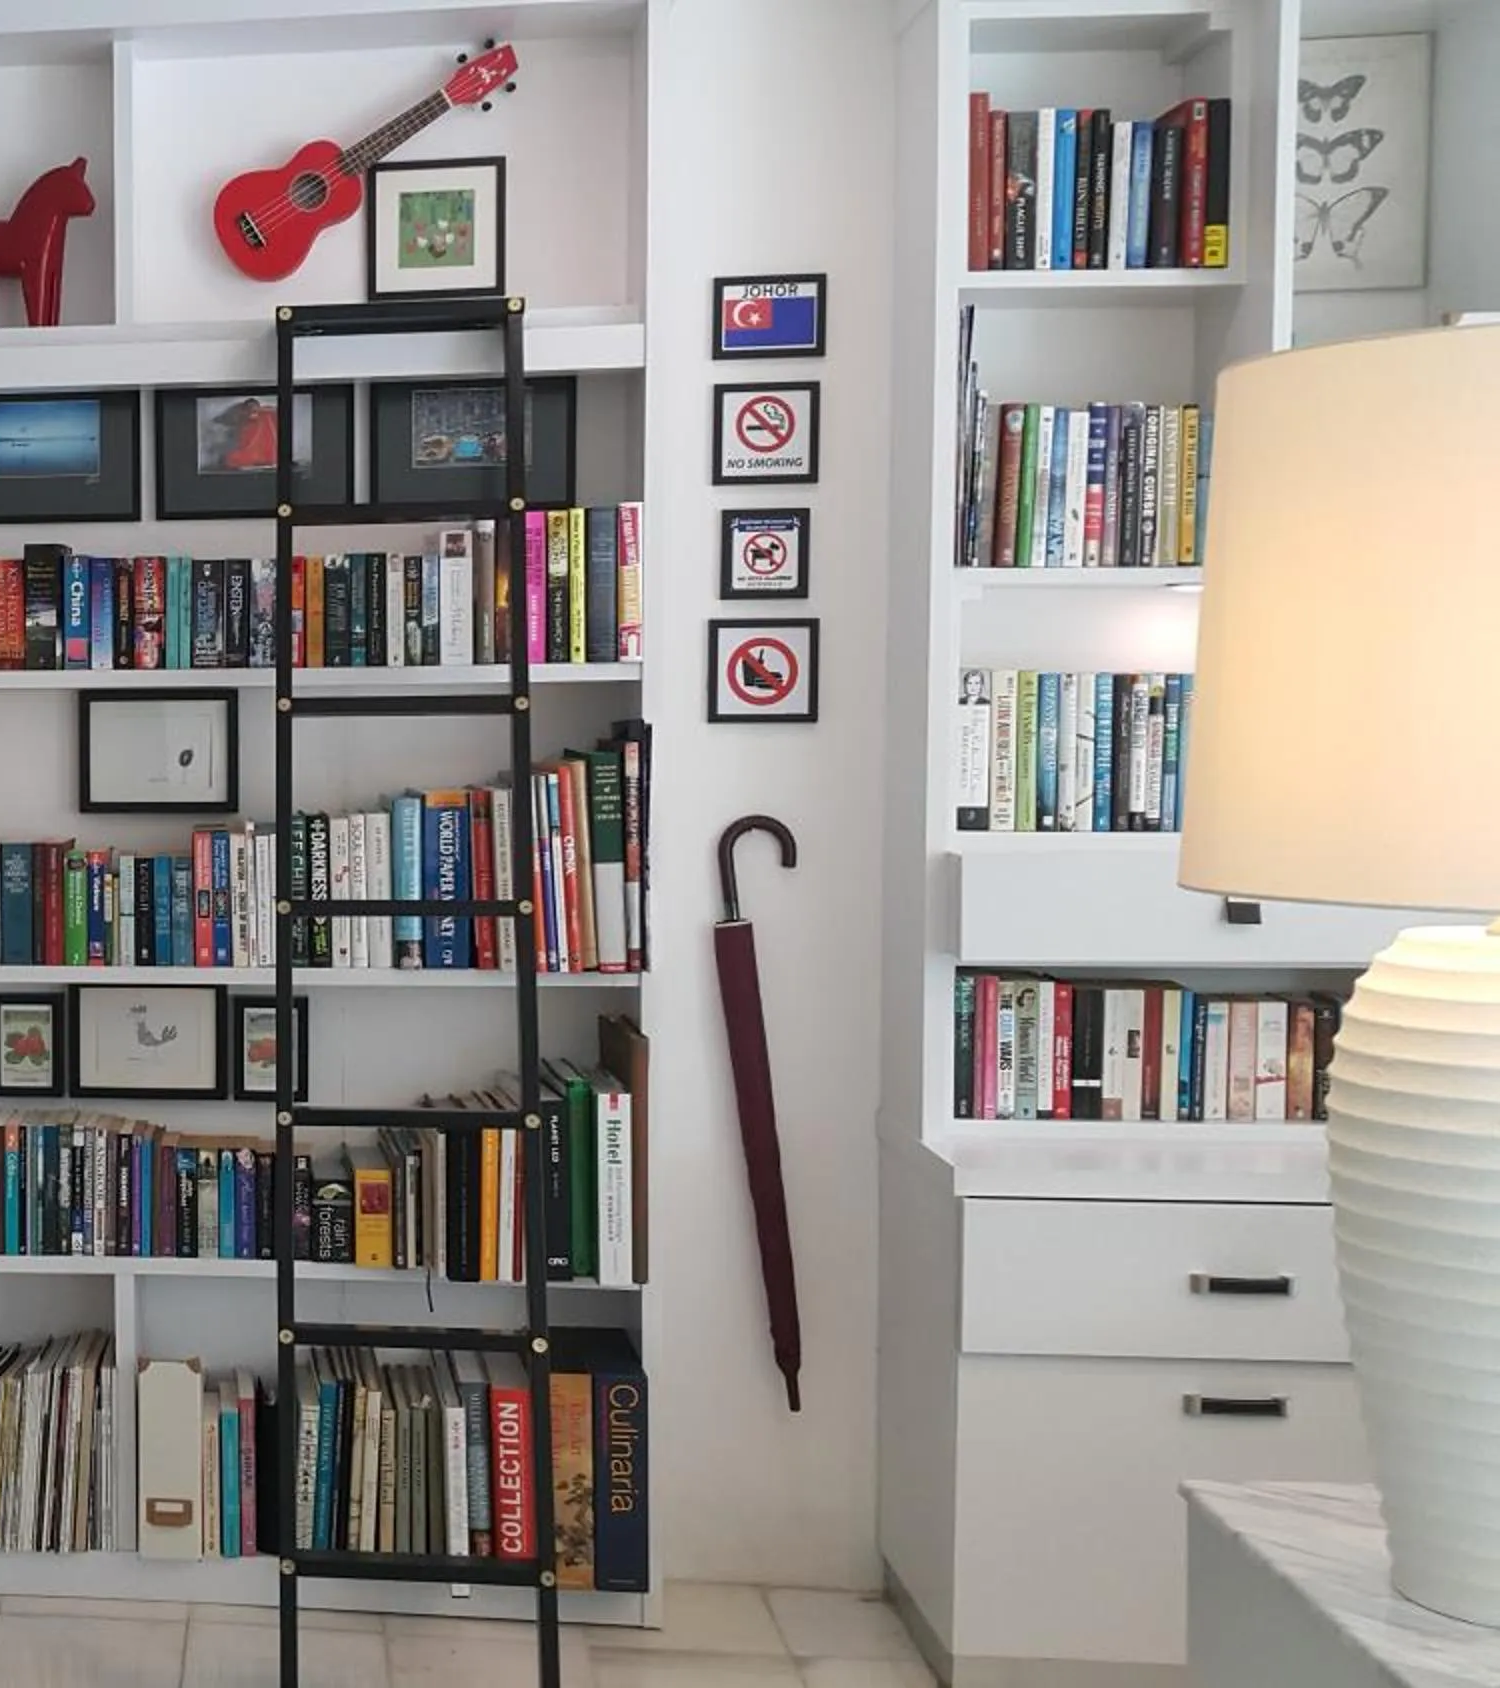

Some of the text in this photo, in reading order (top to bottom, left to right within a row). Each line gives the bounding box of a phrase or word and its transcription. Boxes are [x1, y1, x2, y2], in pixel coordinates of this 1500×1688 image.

[741, 284, 800, 299] JOHOR
[726, 457, 803, 470] NO SMOKING
[7, 566, 19, 593] KEN
[70, 580, 85, 628] China
[439, 811, 455, 855] WORLD
[311, 830, 328, 900] DARKNESS
[440, 855, 455, 892] PAPER
[563, 834, 577, 877] CHINA
[606, 1119, 623, 1165] Hotel
[318, 1204, 334, 1259] forests
[333, 1218, 350, 1247] rain
[609, 1384, 640, 1513] Culinaria
[499, 1401, 523, 1554] COLLECTION
